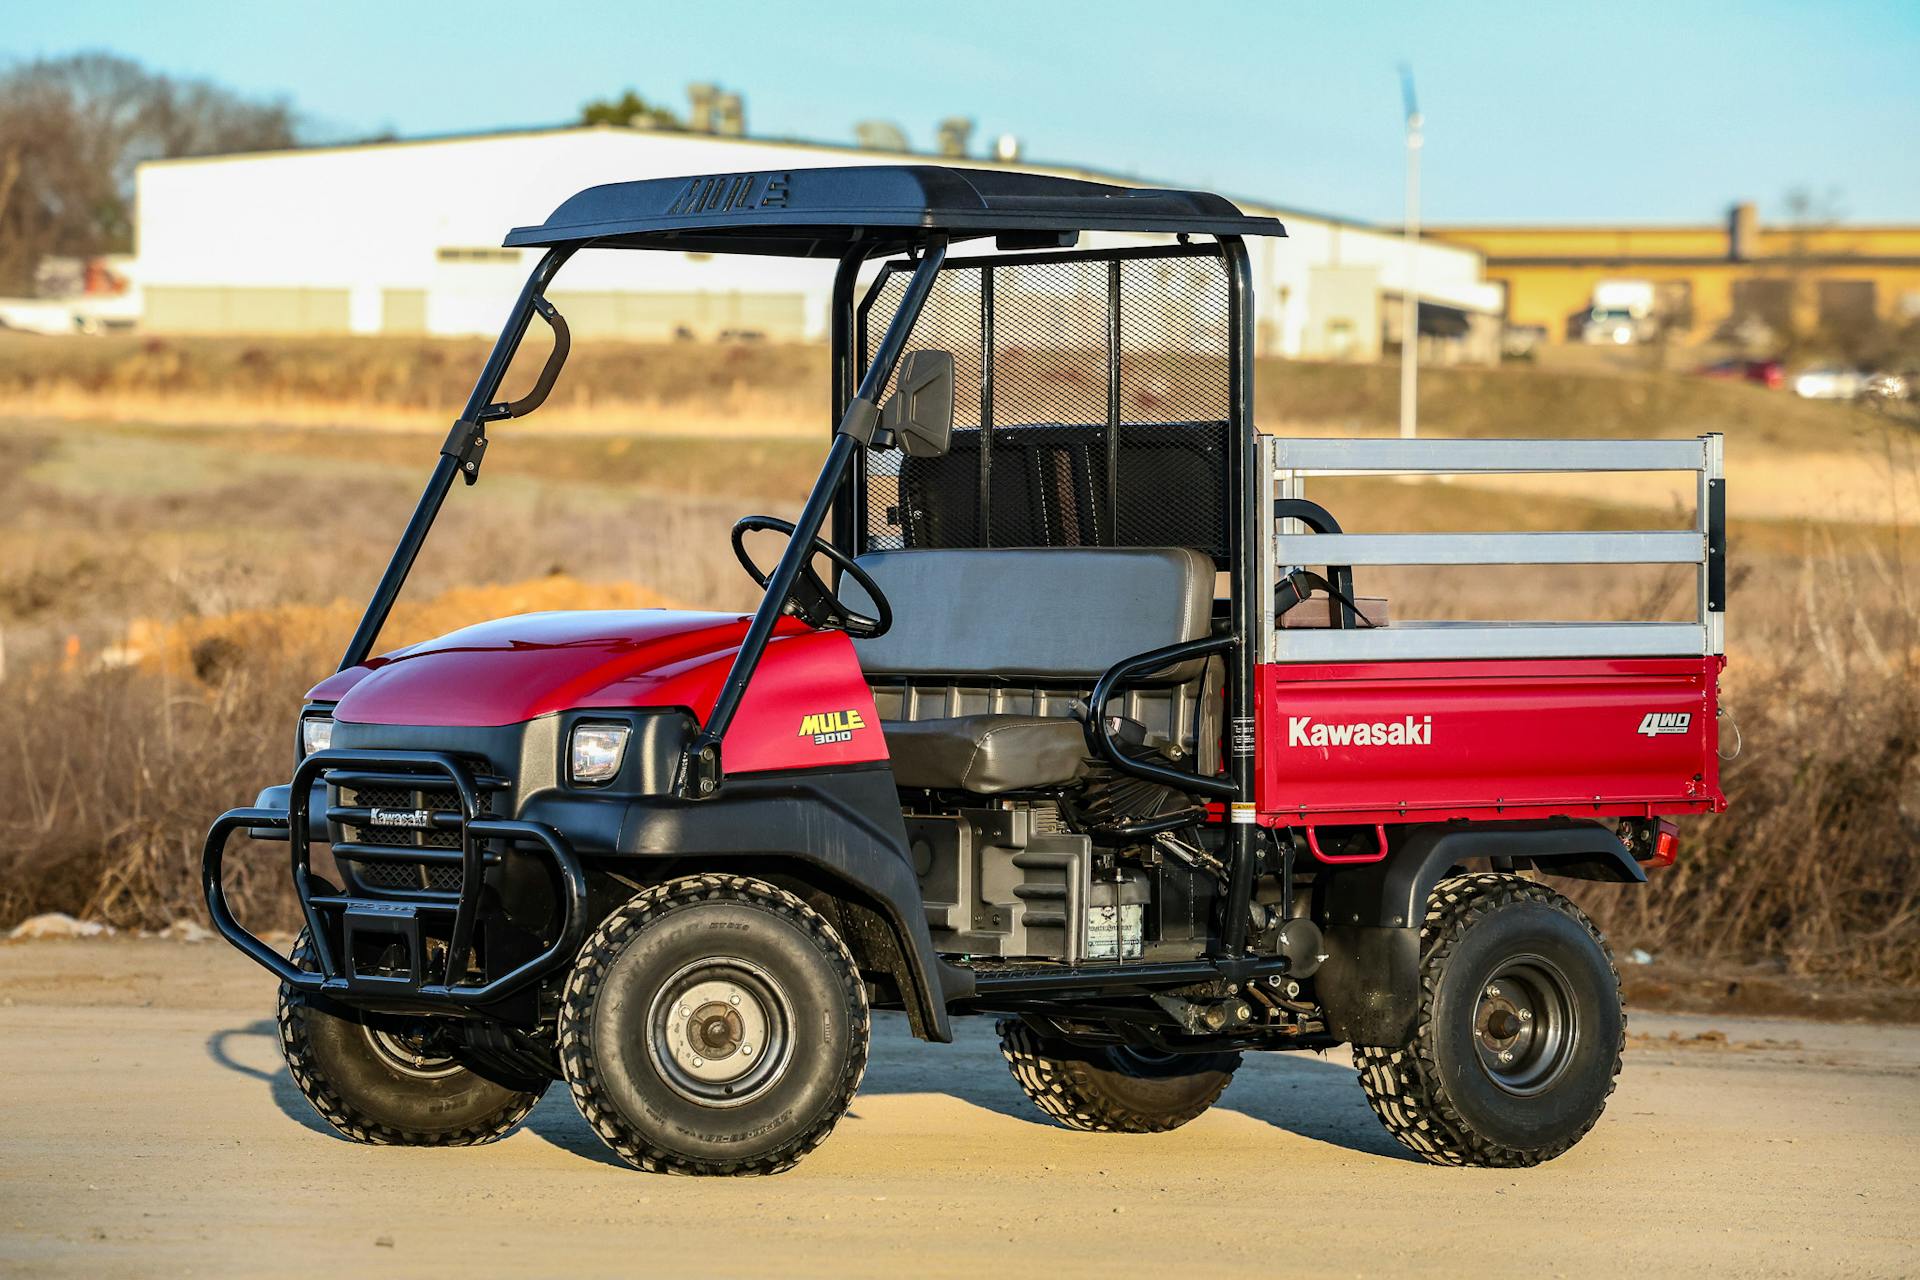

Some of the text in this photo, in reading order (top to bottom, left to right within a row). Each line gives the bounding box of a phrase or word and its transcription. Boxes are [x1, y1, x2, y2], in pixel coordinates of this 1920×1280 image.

[798, 709, 866, 736] MULE
[1288, 715, 1432, 747] Kawasaki
[1637, 713, 1691, 737] 4WD
[814, 731, 852, 745] 3010
[370, 807, 429, 828] Kawasaki
